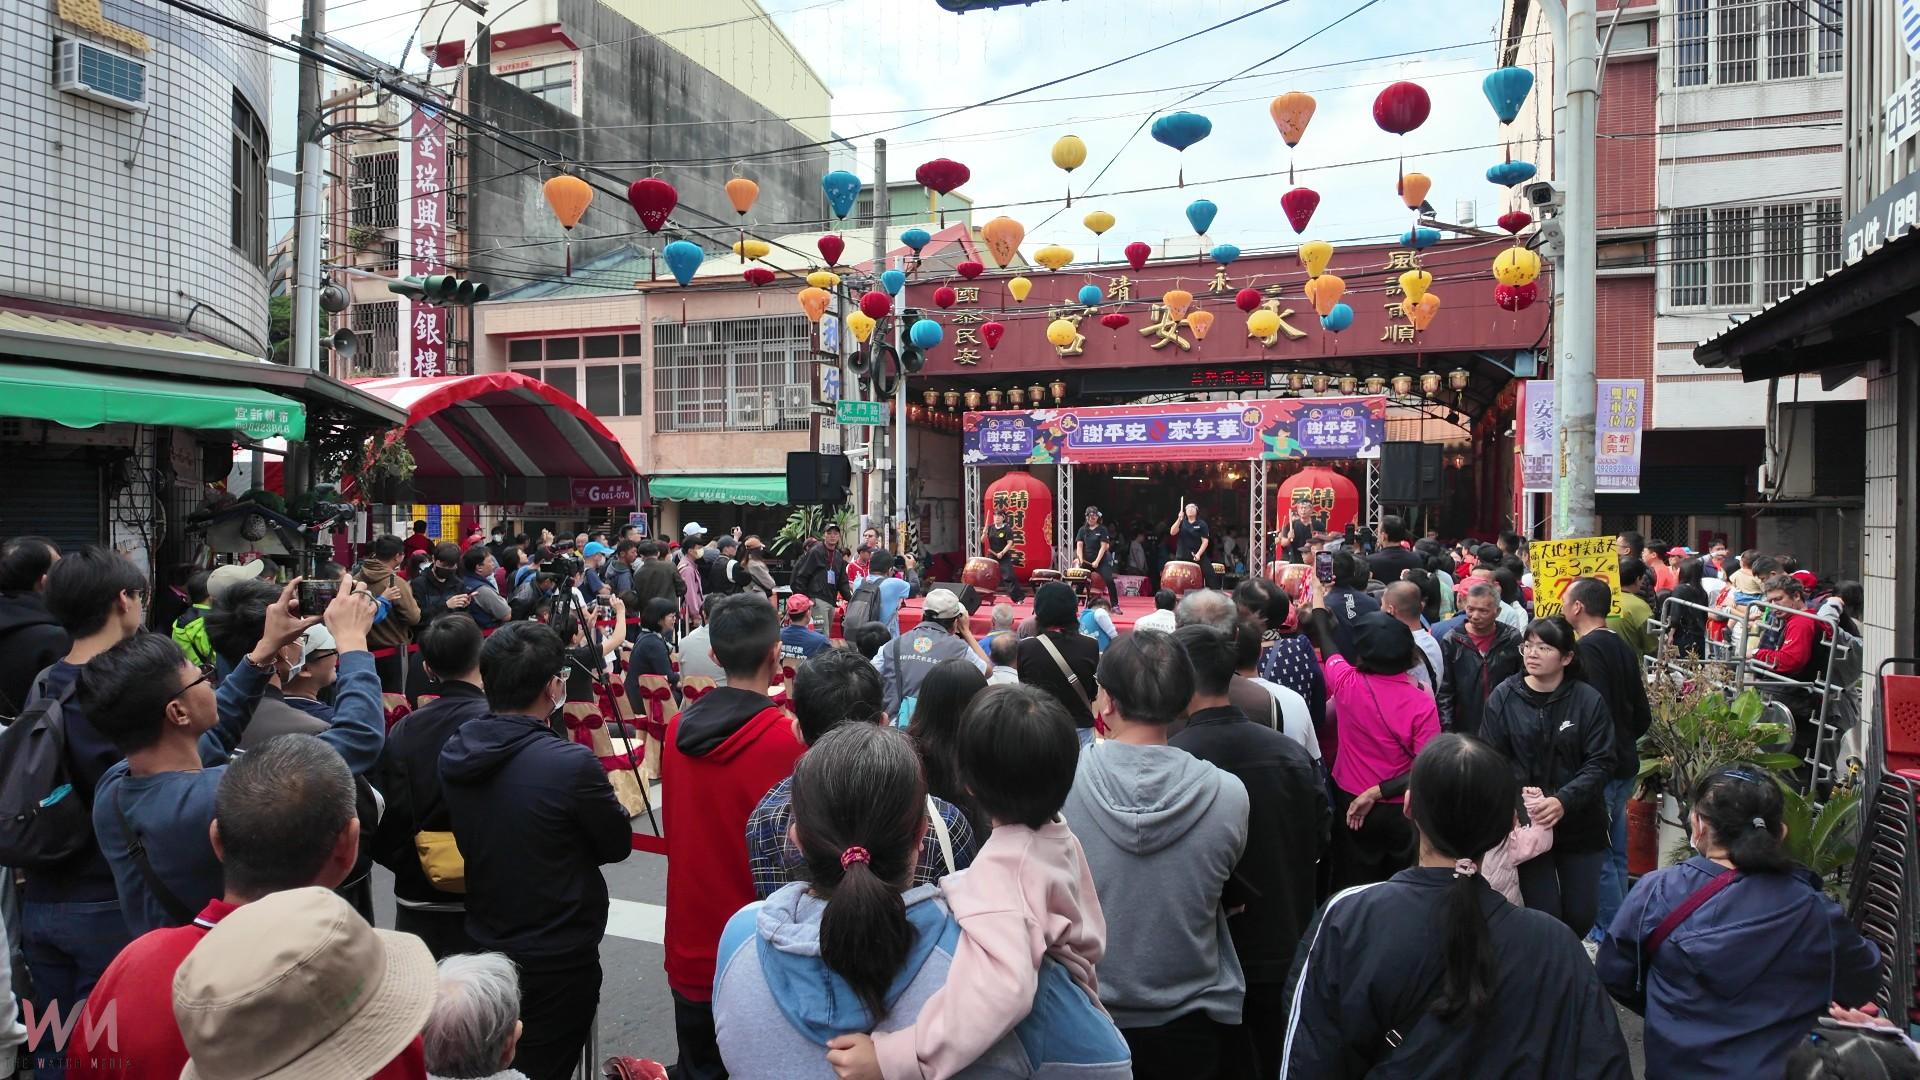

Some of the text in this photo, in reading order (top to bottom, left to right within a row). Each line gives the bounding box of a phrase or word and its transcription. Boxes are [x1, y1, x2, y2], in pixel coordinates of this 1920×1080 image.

[413, 123, 443, 377] 金瑞興珠銀樓
[952, 287, 983, 365] 國泰民安
[843, 403, 879, 416] 東門路
[1307, 420, 1356, 434] 謝平安
[1534, 400, 1553, 441] 安家
[986, 430, 1026, 442] 謝平安
[1082, 418, 1240, 443] 謝平安 家年華
[1607, 434, 1630, 444] 全新
[1606, 444, 1629, 453] 完工
[588, 486, 600, 501] G
[601, 491, 630, 500] 061-070
